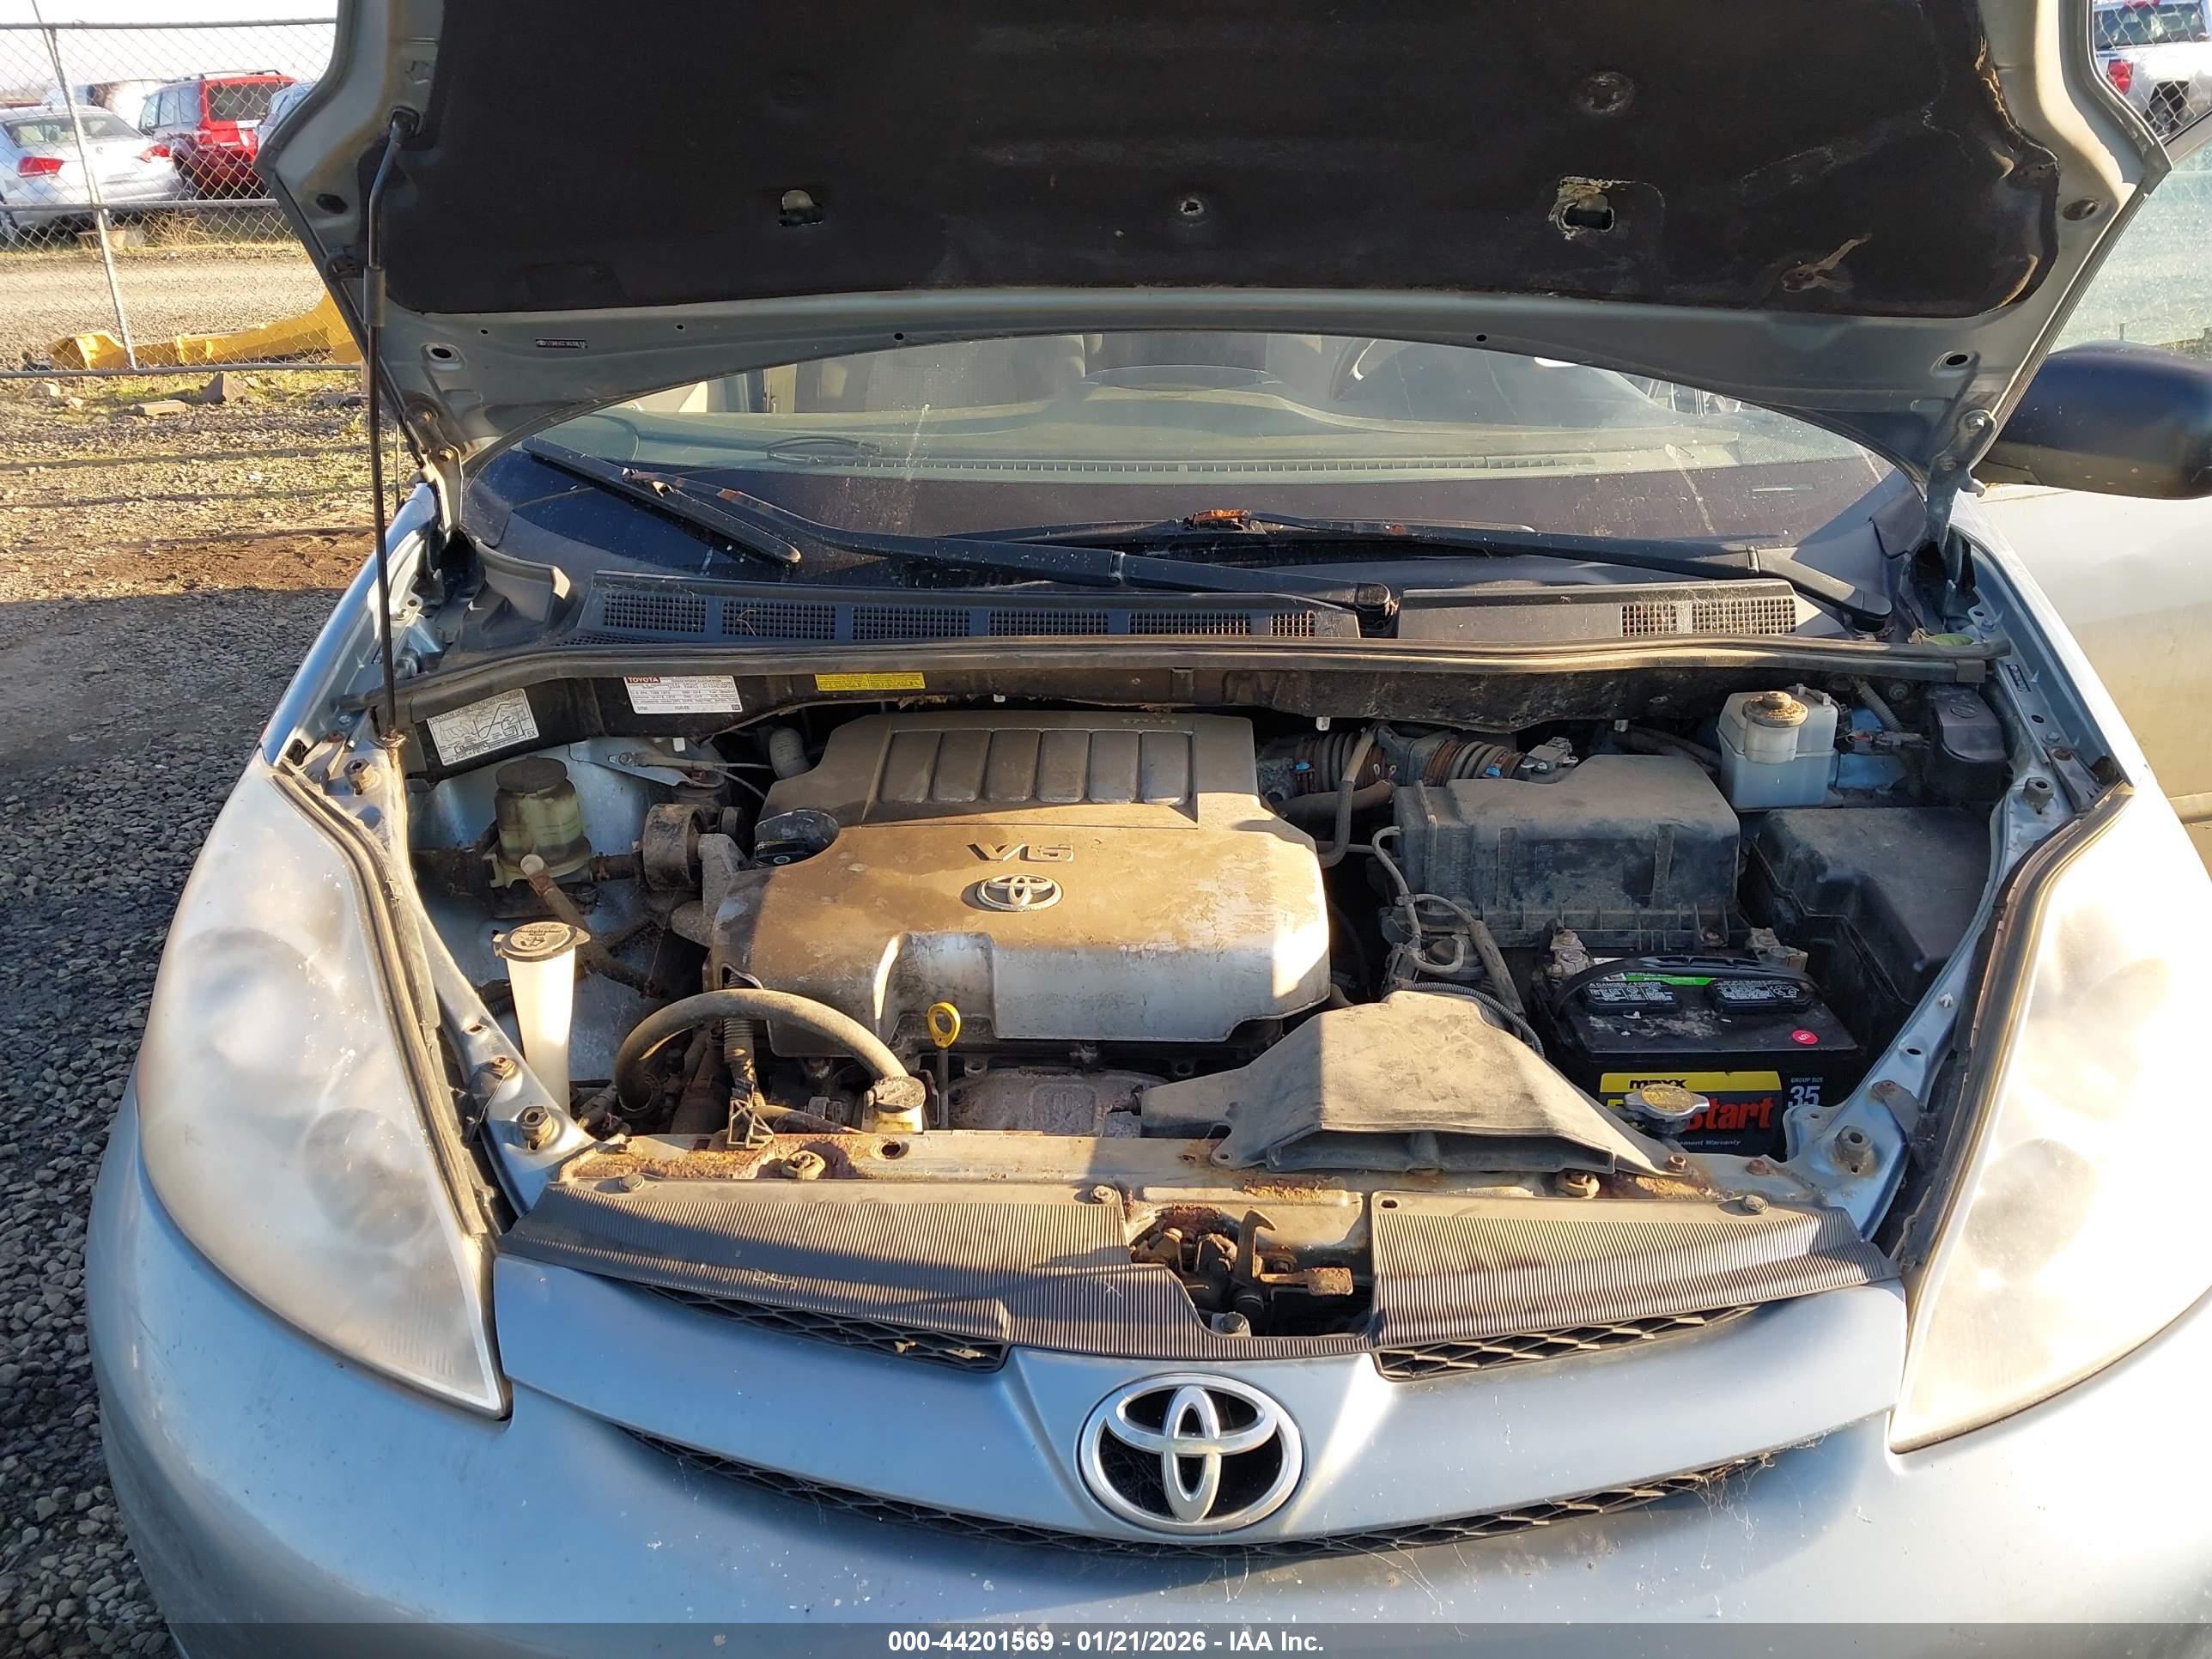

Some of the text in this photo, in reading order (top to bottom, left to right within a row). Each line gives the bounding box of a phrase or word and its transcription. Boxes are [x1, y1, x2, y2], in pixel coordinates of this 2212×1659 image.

[430, 712, 455, 724] VACUUM
[967, 842, 1074, 863] V6
[1787, 1085, 1821, 1108] 35
